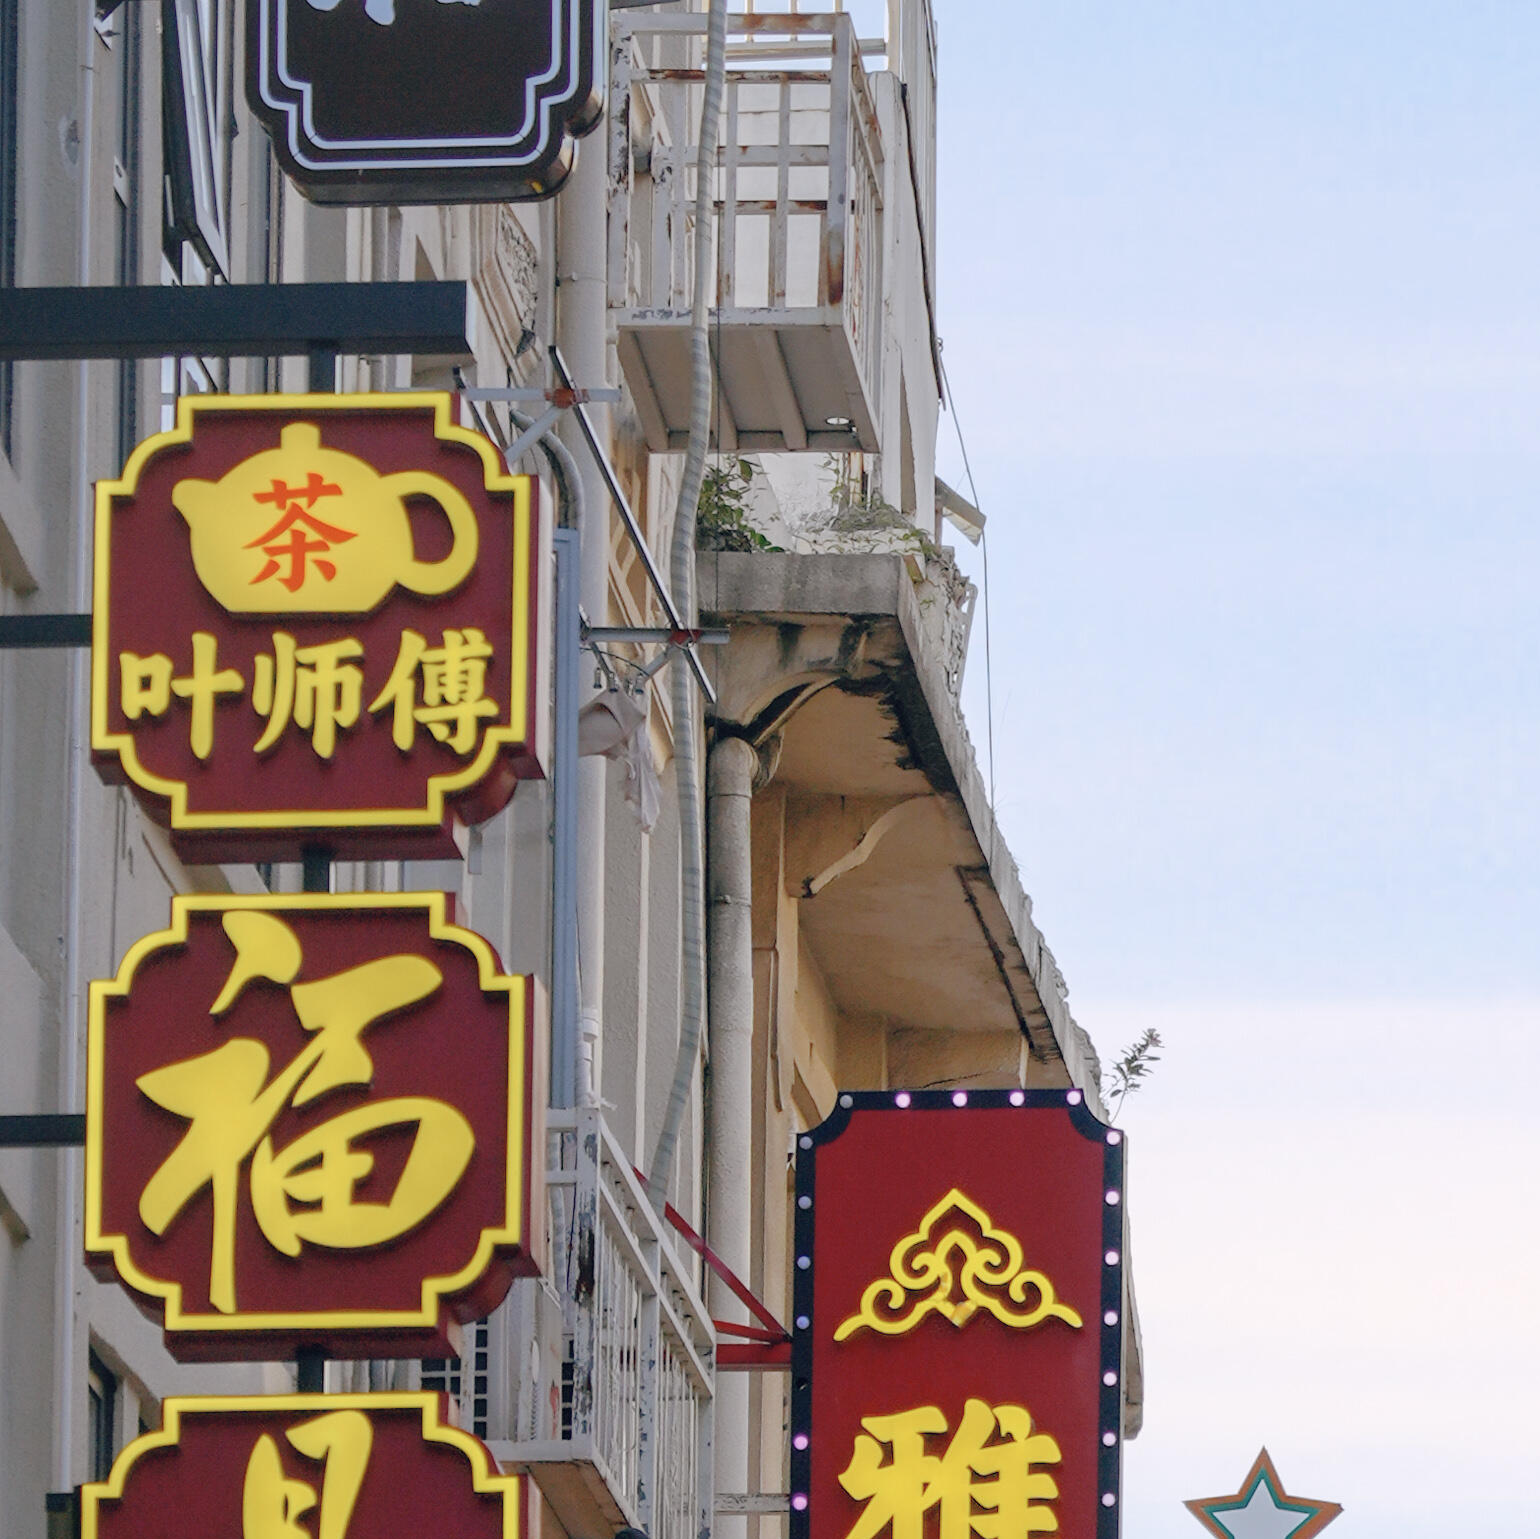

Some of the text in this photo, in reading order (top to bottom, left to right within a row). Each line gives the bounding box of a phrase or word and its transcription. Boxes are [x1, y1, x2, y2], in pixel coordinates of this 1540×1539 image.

[242, 472, 361, 593] 茶
[118, 625, 500, 760] 叶师傅
